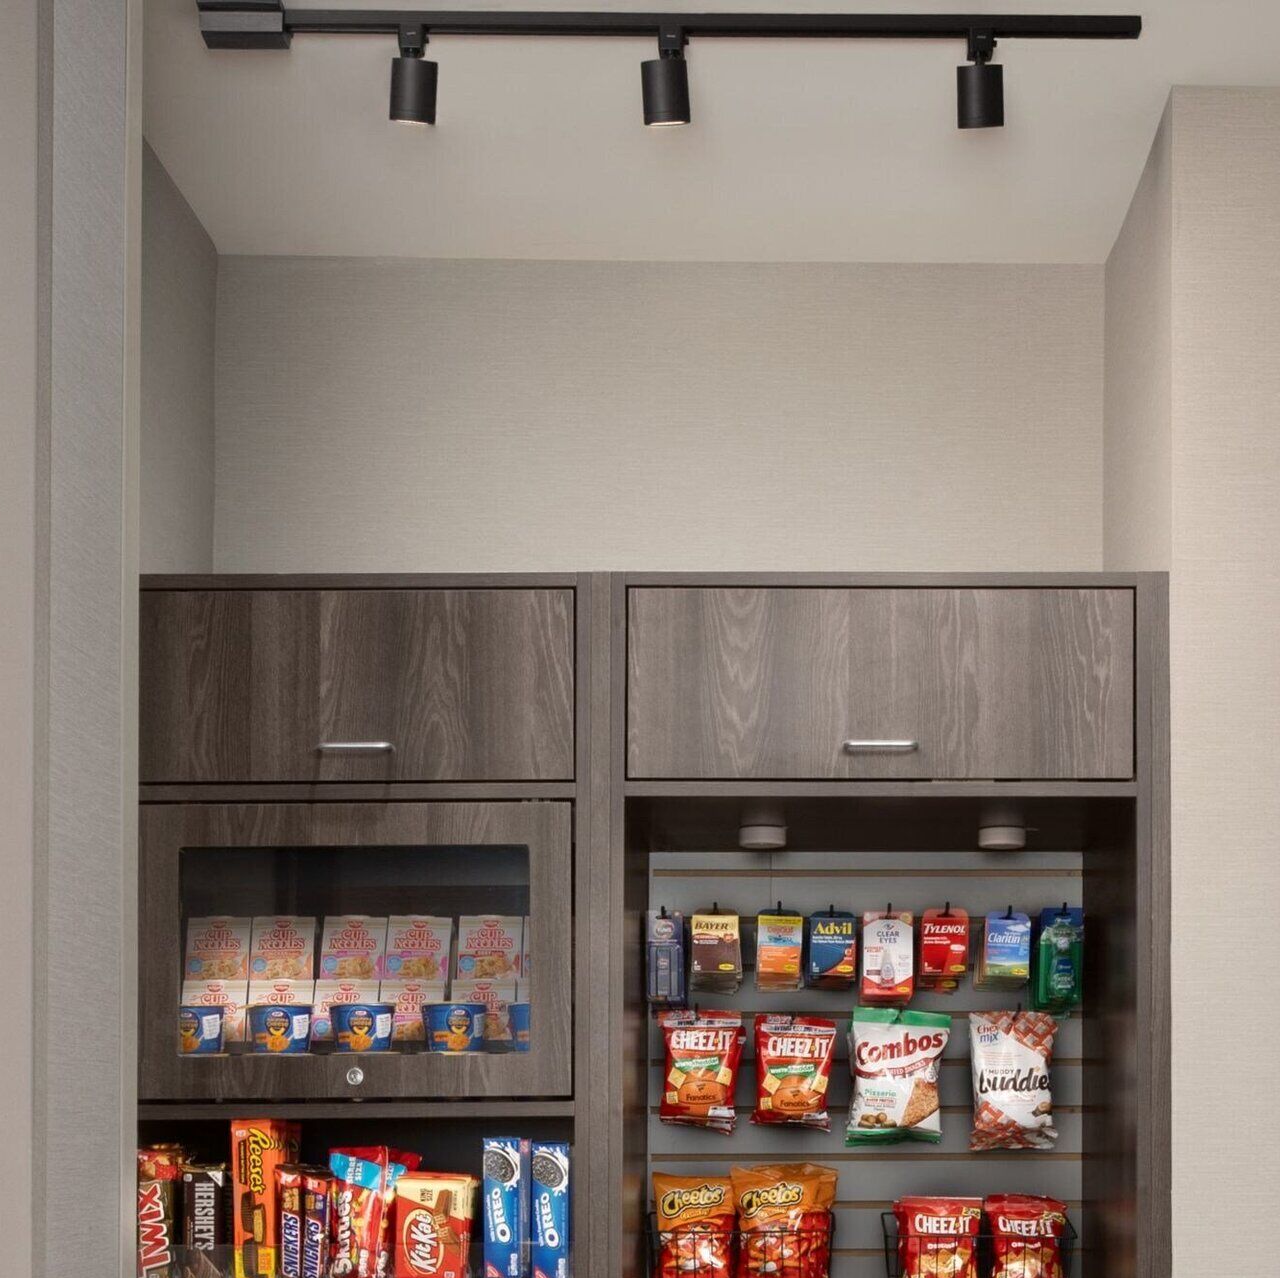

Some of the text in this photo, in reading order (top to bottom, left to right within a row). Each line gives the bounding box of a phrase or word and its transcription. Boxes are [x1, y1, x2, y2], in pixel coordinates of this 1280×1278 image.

[694, 922, 729, 930] BAYER
[813, 922, 853, 935] Advil
[924, 923, 966, 934] TYLENOL
[206, 929, 232, 939] CUP
[271, 929, 297, 939] CUP
[342, 929, 368, 939] CUP
[406, 929, 433, 939] CUP
[477, 929, 504, 938] CUP
[987, 932, 1021, 944] Claritin
[201, 993, 228, 1004] CUP
[267, 993, 295, 1004] CUP
[333, 993, 360, 1004] CUP
[398, 993, 426, 1004] CUP
[471, 992, 497, 1001] CUP
[979, 1033, 1000, 1044] mix
[856, 1032, 944, 1067] Combos
[979, 1066, 1052, 1095] buddie
[686, 1093, 715, 1101] Fanatics
[864, 1088, 897, 1097] Pizzeria
[248, 1127, 271, 1195] Reese's
[661, 1186, 724, 1217] Cheetos
[741, 1183, 802, 1217] Cheetos
[194, 1182, 215, 1250] HERSHEY'S
[491, 1187, 511, 1243] OREO
[540, 1192, 560, 1248] OREO
[334, 1190, 353, 1275] Skittles
[283, 1213, 300, 1278] SNICKERS
